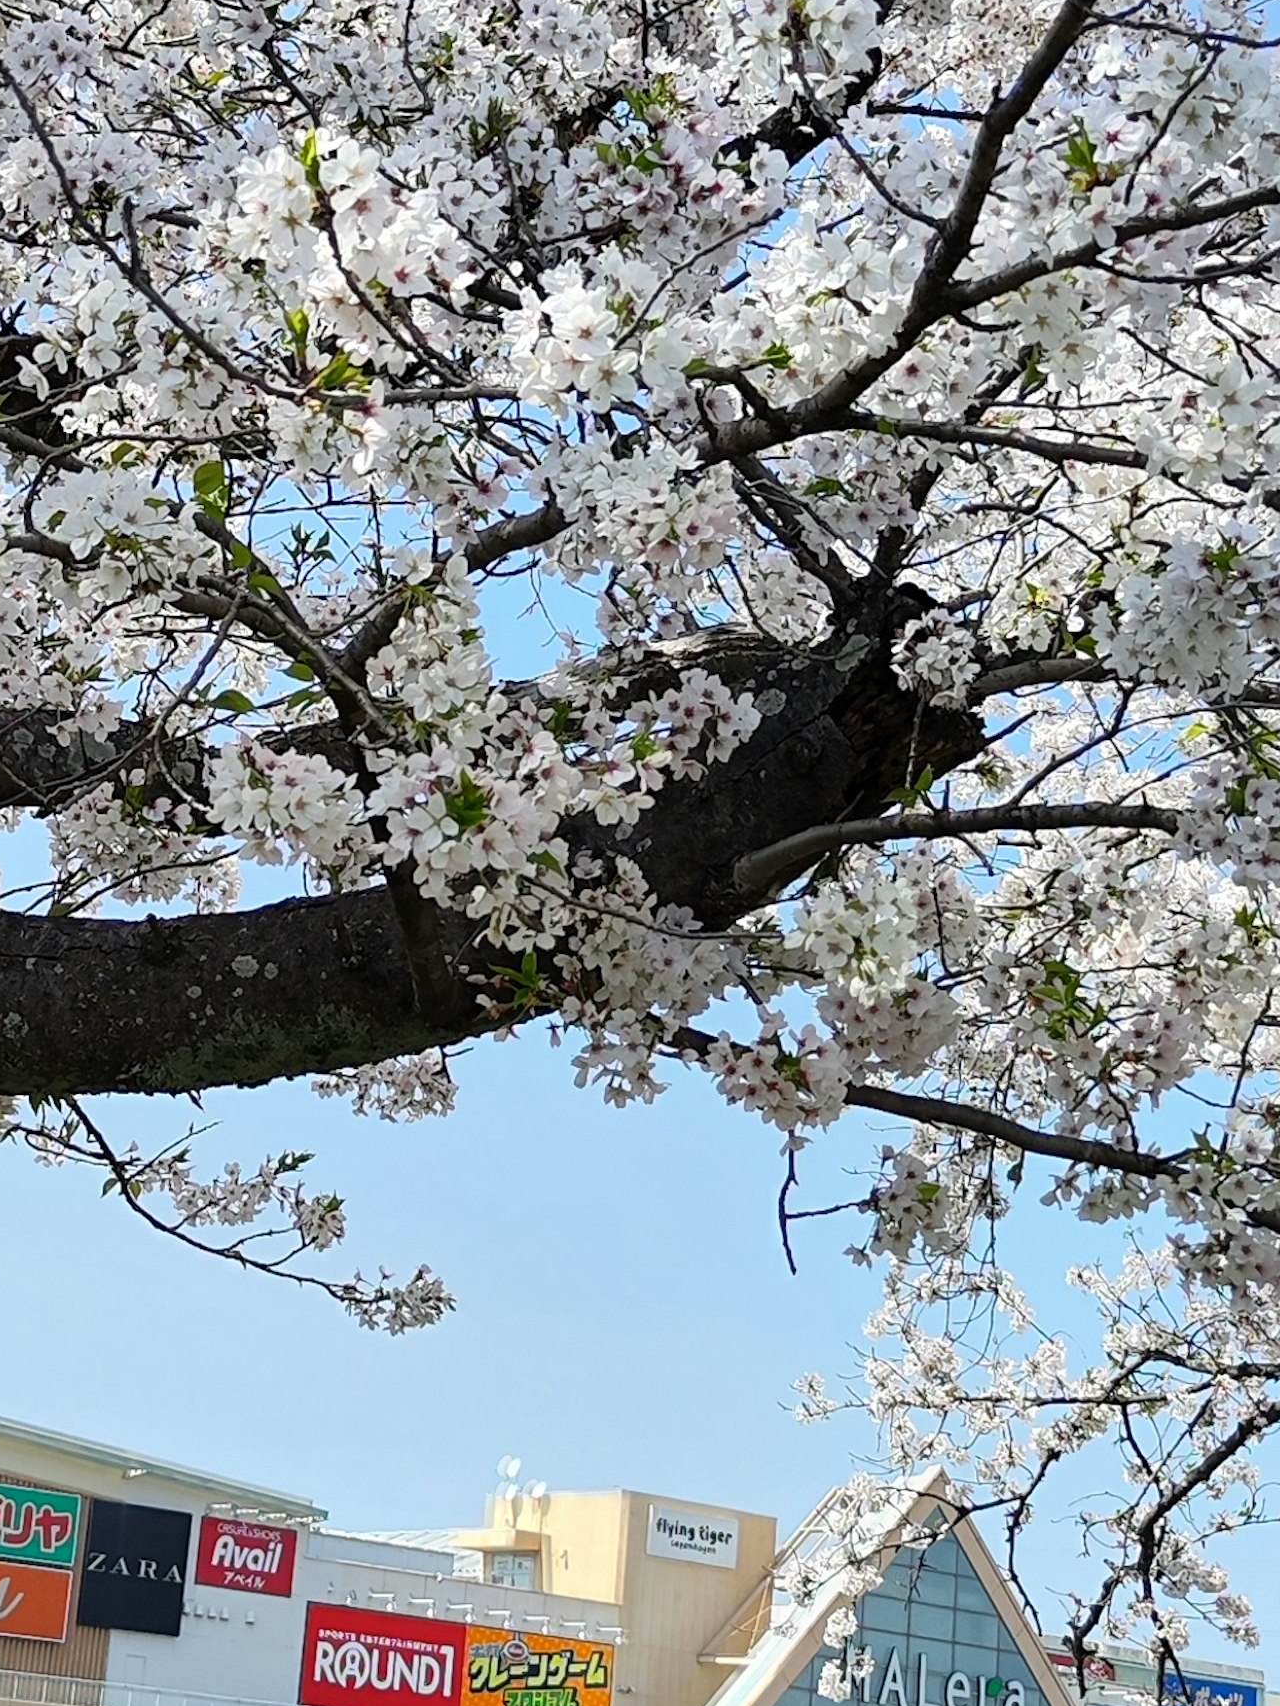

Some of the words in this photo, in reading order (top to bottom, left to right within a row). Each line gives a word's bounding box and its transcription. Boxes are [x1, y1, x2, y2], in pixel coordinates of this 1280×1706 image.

[656, 1517, 696, 1541] flying
[699, 1525, 733, 1545] tiger
[87, 1552, 183, 1584] ZARA
[211, 1534, 284, 1574] Avail
[470, 1651, 608, 1692] クレーンゲーム
